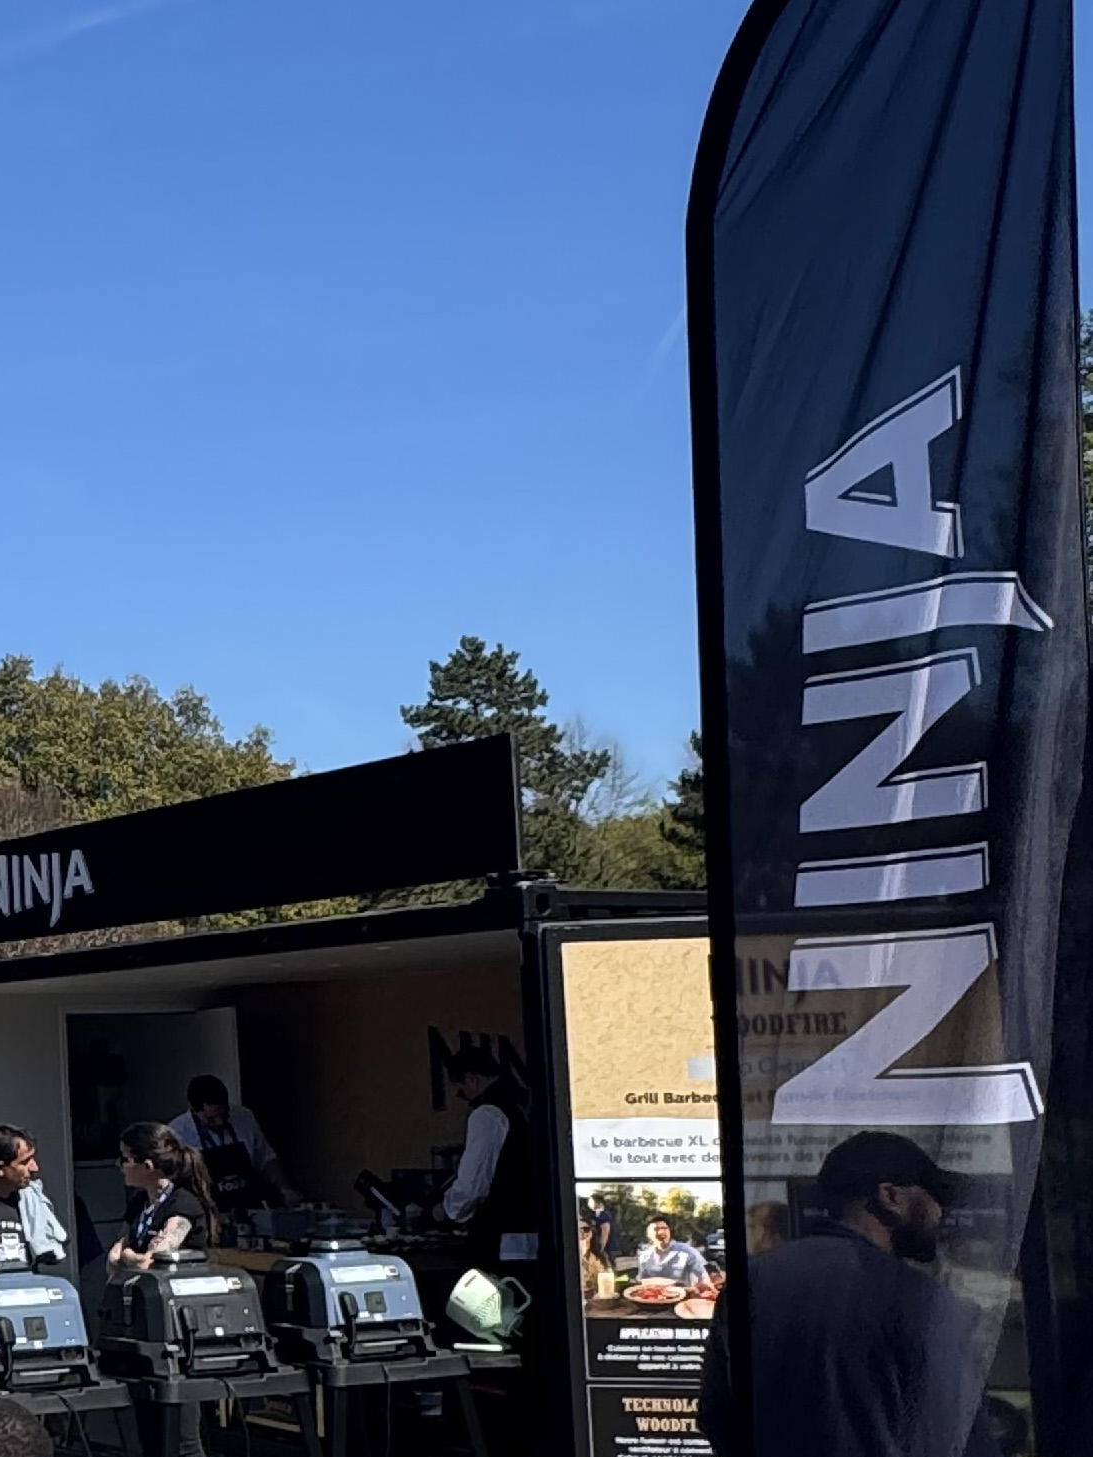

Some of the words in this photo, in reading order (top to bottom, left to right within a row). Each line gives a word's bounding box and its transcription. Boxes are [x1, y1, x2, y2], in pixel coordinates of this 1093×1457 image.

[771, 365, 1054, 1124] NINJA
[624, 1091, 658, 1104] Grill
[663, 1091, 719, 1104] Barbec
[591, 1136, 608, 1148] Le
[613, 1136, 683, 1148] barbecue
[688, 1135, 707, 1147] XL
[610, 1152, 622, 1163] le
[627, 1152, 658, 1163] tout
[662, 1153, 696, 1163] avec
